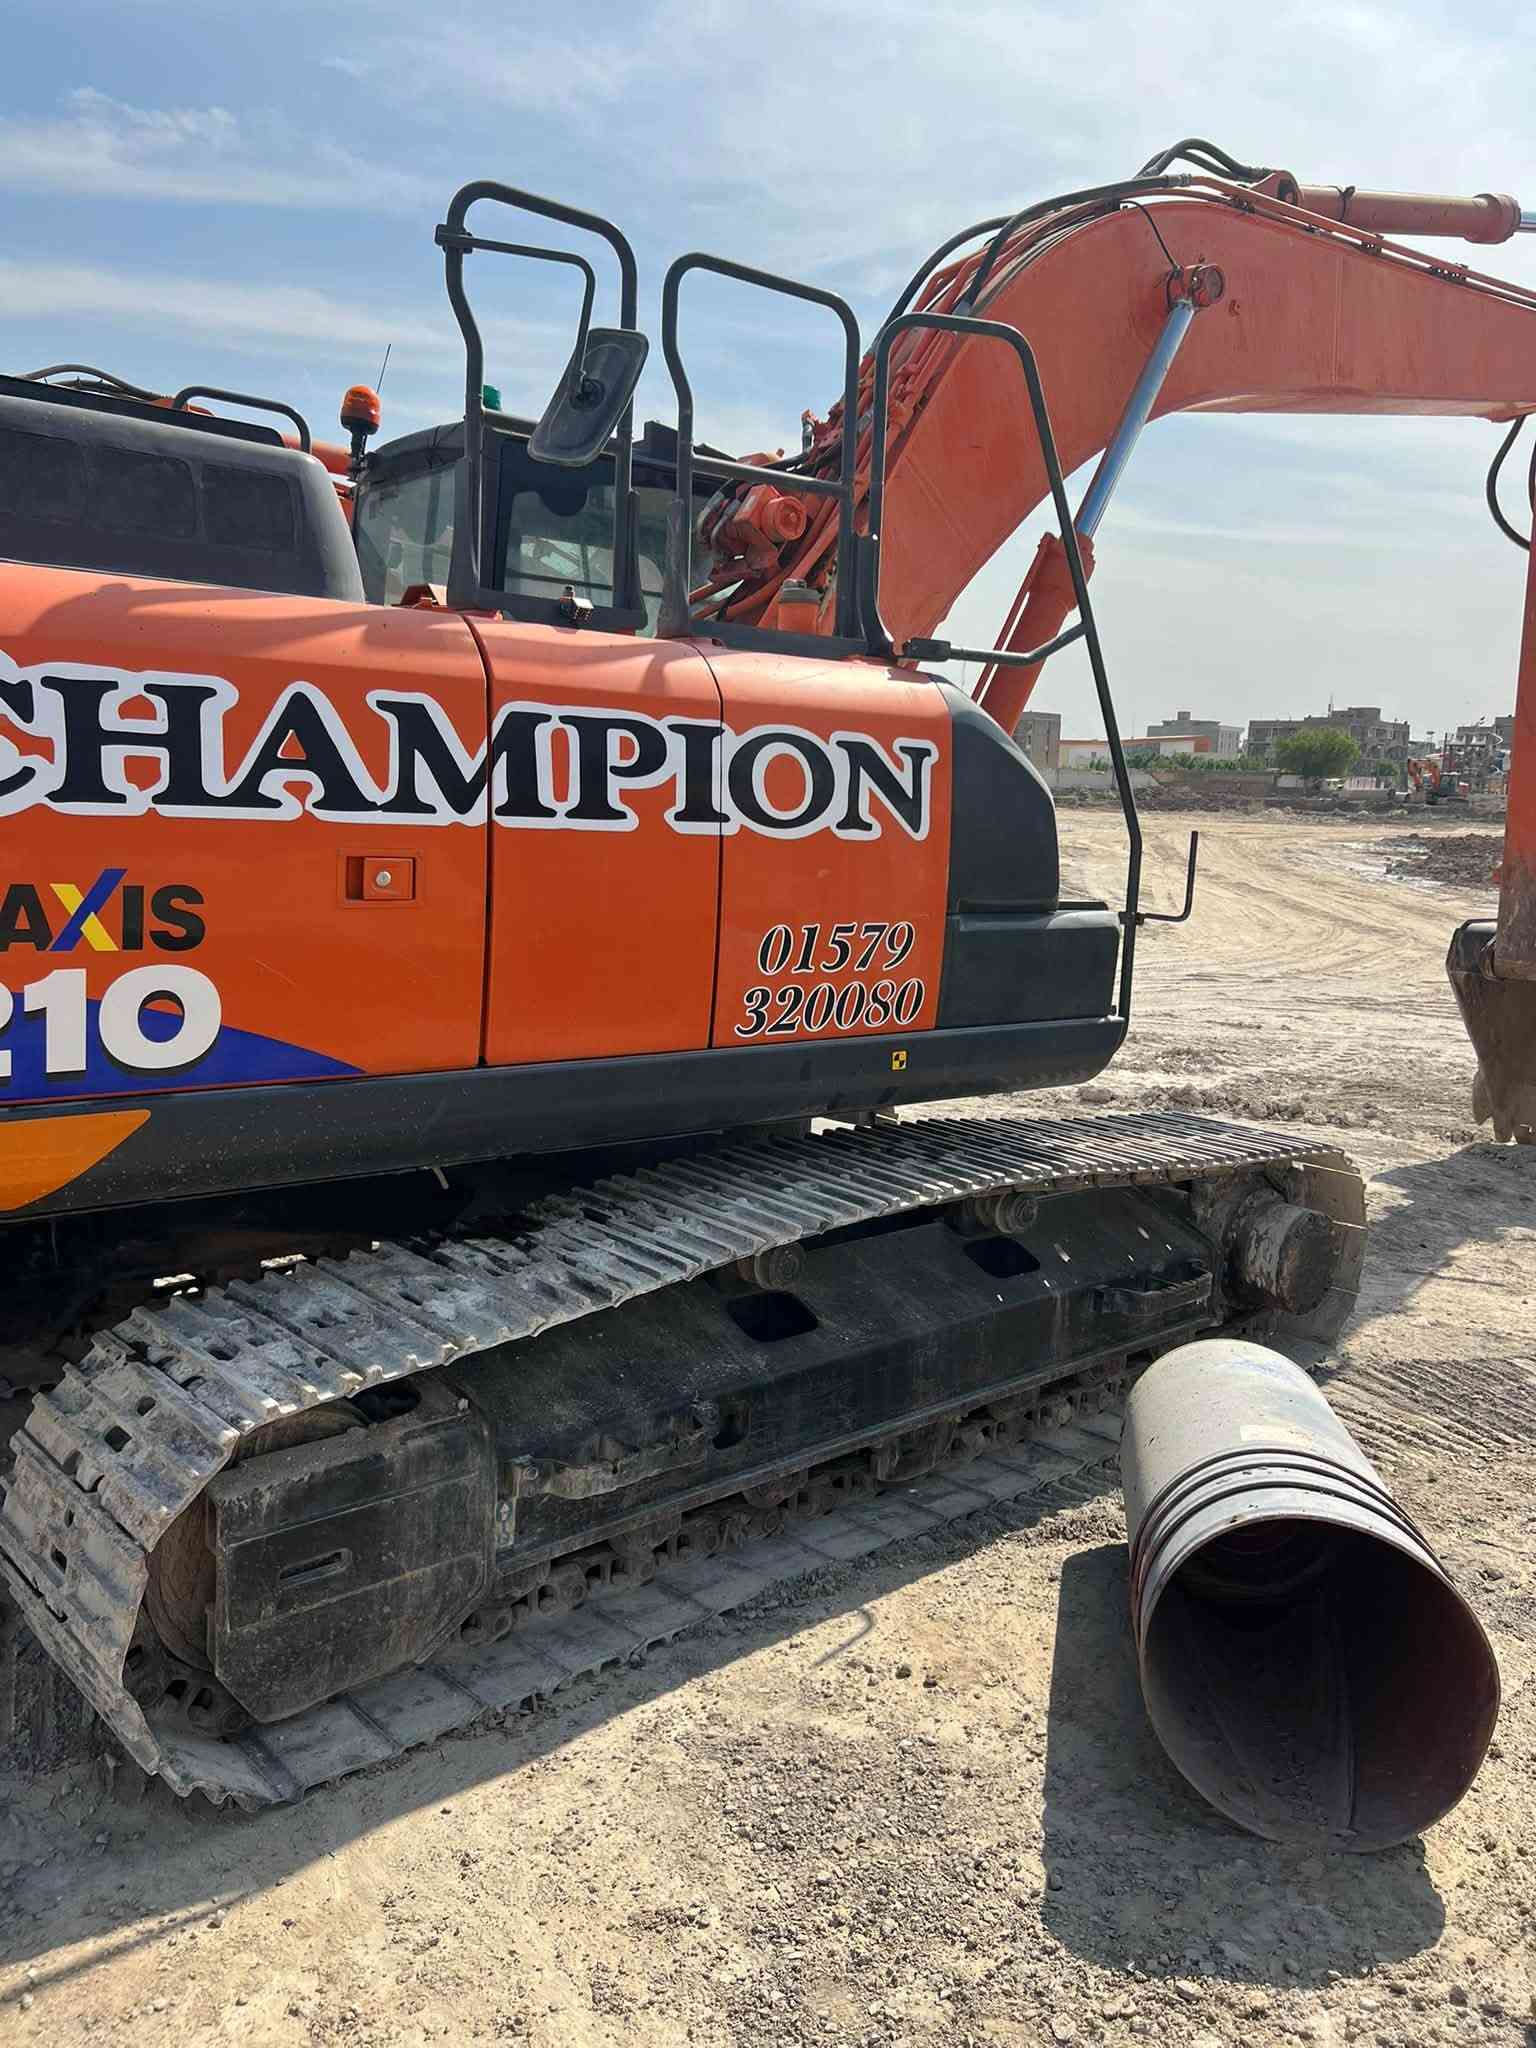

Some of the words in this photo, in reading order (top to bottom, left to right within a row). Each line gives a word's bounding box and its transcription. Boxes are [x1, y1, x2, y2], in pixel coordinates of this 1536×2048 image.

[0, 868, 206, 951] AXIS
[758, 922, 915, 976] 01579
[0, 964, 222, 1078] 10
[734, 978, 925, 1037] 320080
